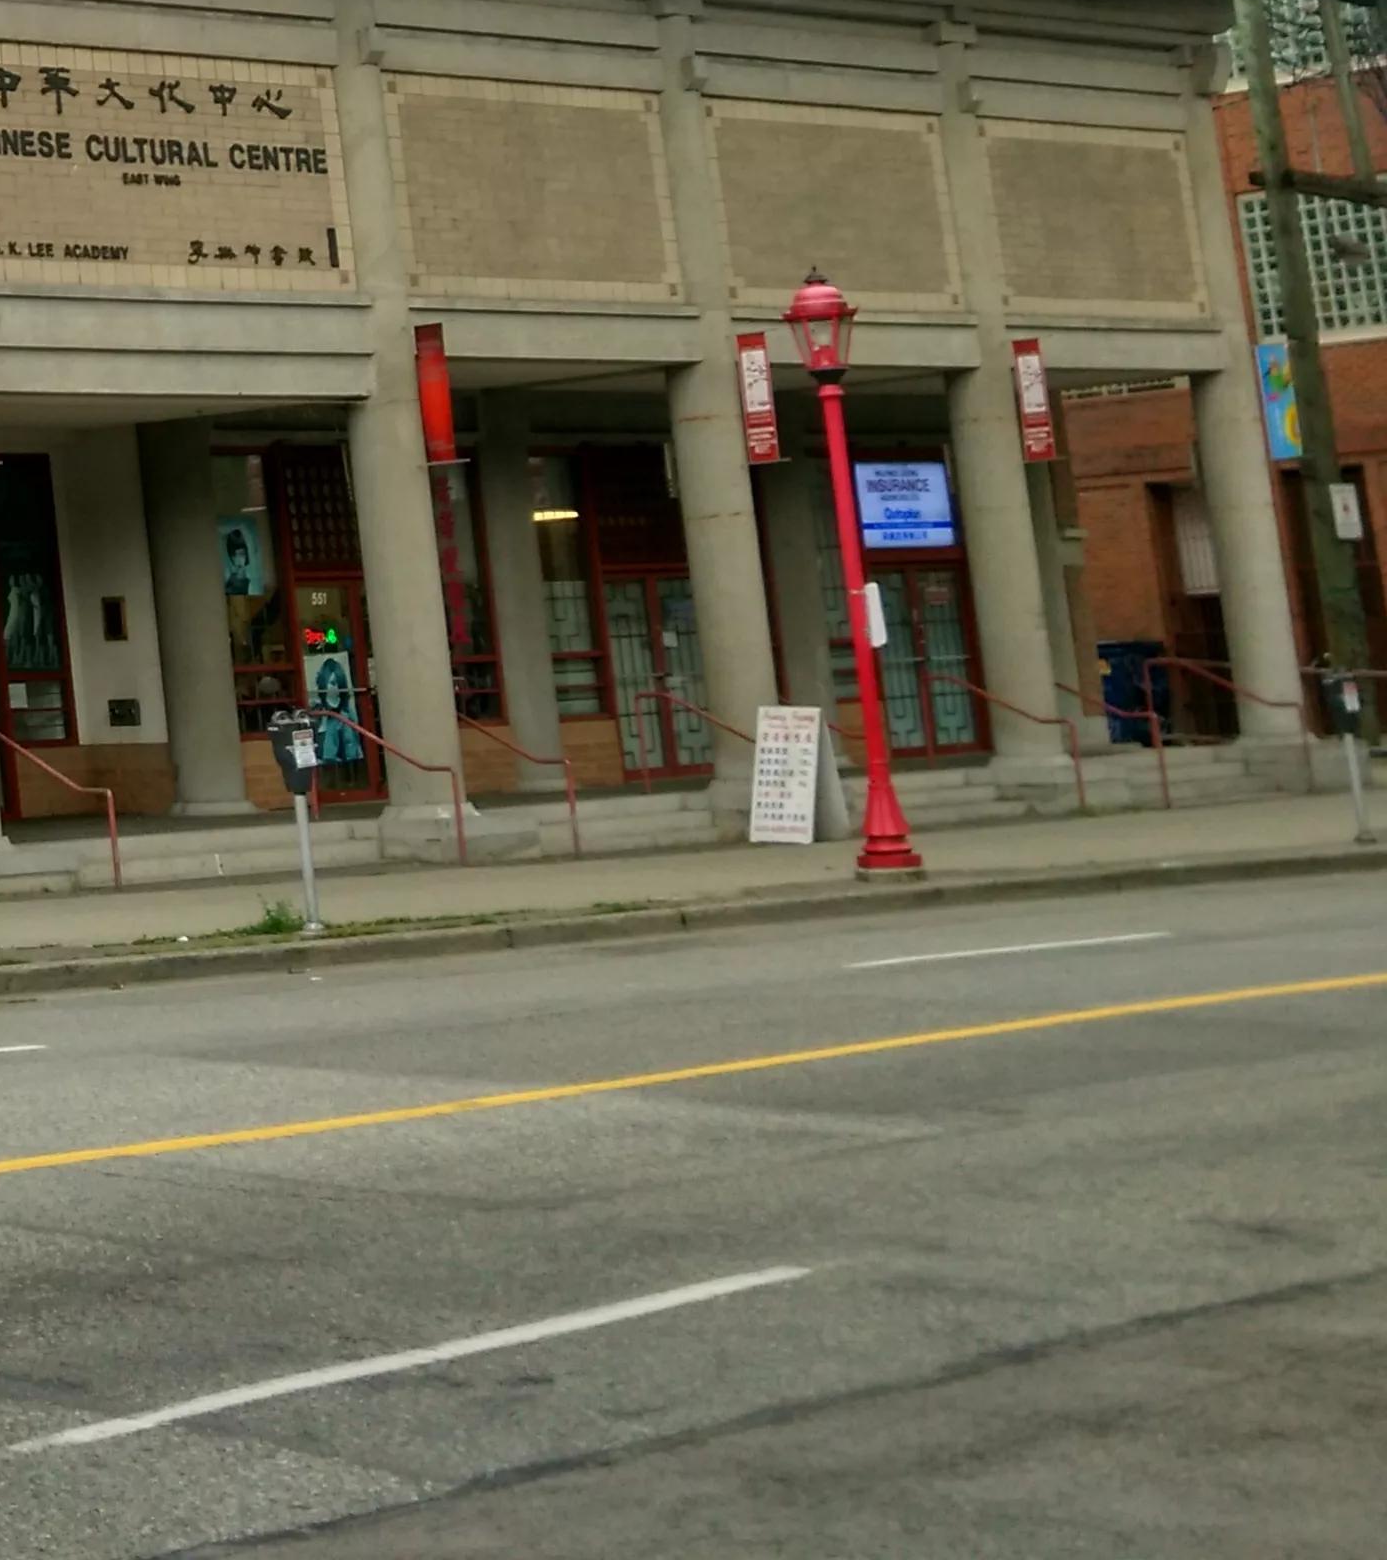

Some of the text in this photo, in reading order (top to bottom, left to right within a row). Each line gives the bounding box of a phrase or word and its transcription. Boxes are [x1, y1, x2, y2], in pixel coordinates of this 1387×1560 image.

[85, 133, 219, 169] CULTURAL
[228, 143, 329, 175] CENTRE
[122, 172, 181, 187] EAST WING
[8, 241, 22, 256] K.
[27, 242, 54, 258] LEE
[63, 244, 129, 261] ACADEMY
[311, 592, 327, 606] 551
